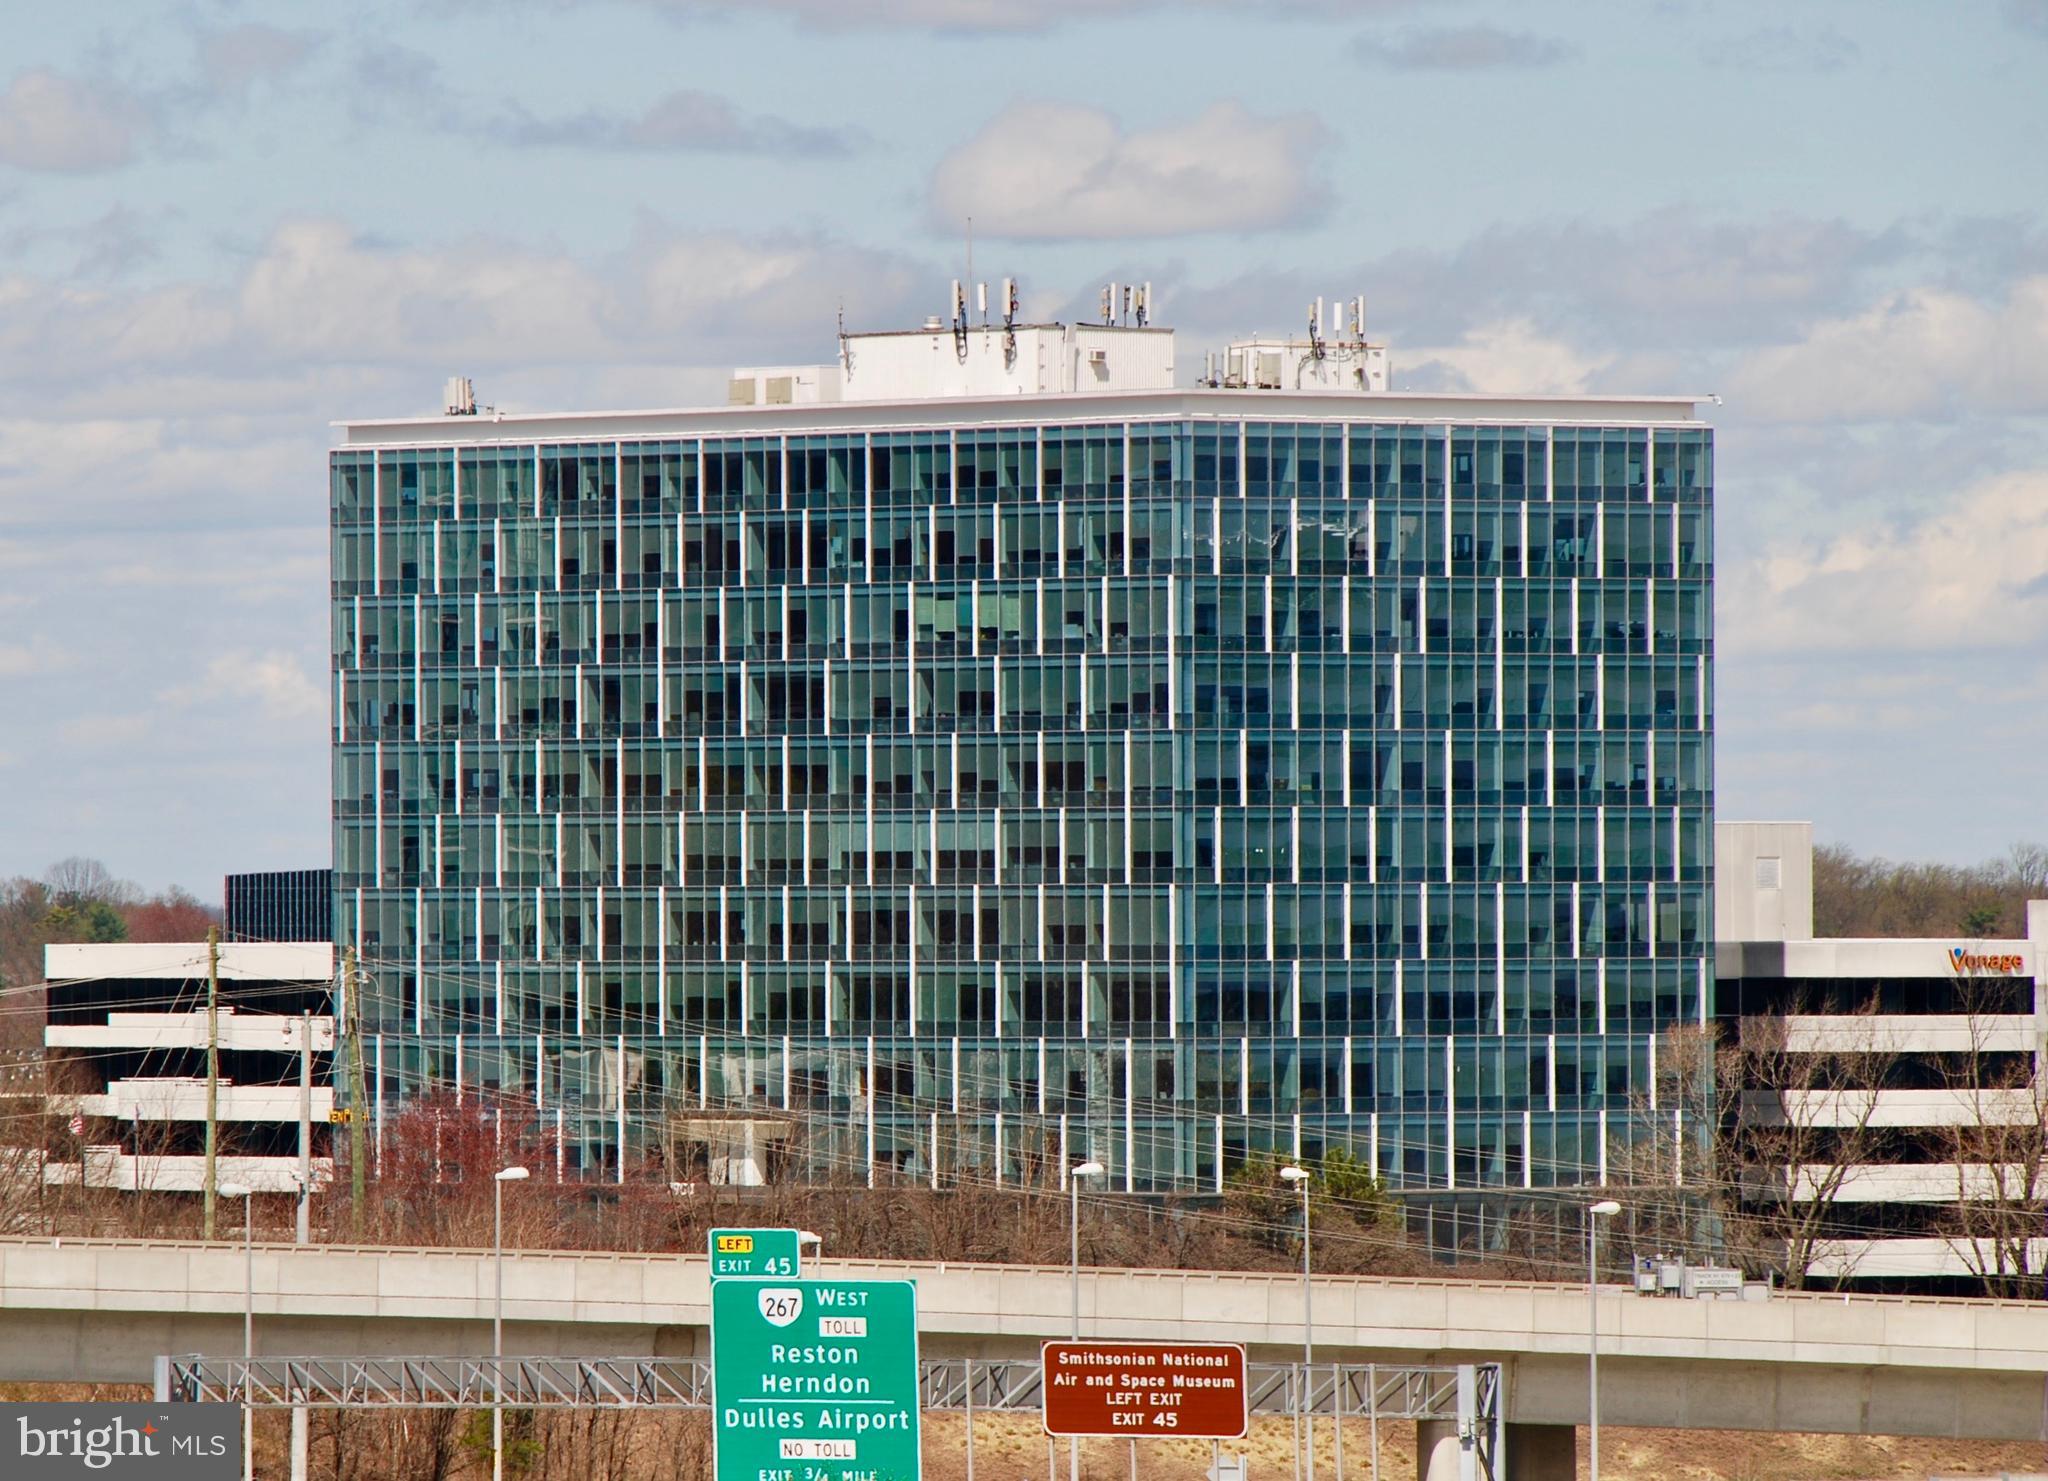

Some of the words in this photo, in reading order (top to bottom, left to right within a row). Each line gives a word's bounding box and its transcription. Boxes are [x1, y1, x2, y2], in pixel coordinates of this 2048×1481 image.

[1948, 949, 2023, 973] Vonage
[718, 1239, 752, 1250] LEFT
[718, 1260, 751, 1272] EXIT
[764, 1257, 791, 1275] 45
[815, 1288, 869, 1306] WEST
[765, 1297, 798, 1317] 267
[825, 1320, 861, 1335] TOLL
[771, 1344, 858, 1364] Reston
[1058, 1352, 1156, 1366] Smithsonian
[1163, 1353, 1229, 1367] National
[761, 1373, 870, 1394] Herndon
[1054, 1373, 1078, 1386] Air
[1085, 1373, 1114, 1387] and
[1121, 1374, 1166, 1389] Space
[1172, 1375, 1236, 1388] Museum
[1106, 1392, 1143, 1405] LEFT
[1150, 1393, 1183, 1406] EXIT
[724, 1408, 805, 1429] Dulles
[818, 1408, 909, 1434] Airport
[1112, 1413, 1145, 1425] EXIT
[1153, 1412, 1178, 1427] 45
[783, 1443, 804, 1457] NO
[814, 1443, 851, 1458] TOLL
[758, 1469, 793, 1481] EXIT
[842, 1470, 878, 1481] MILE
